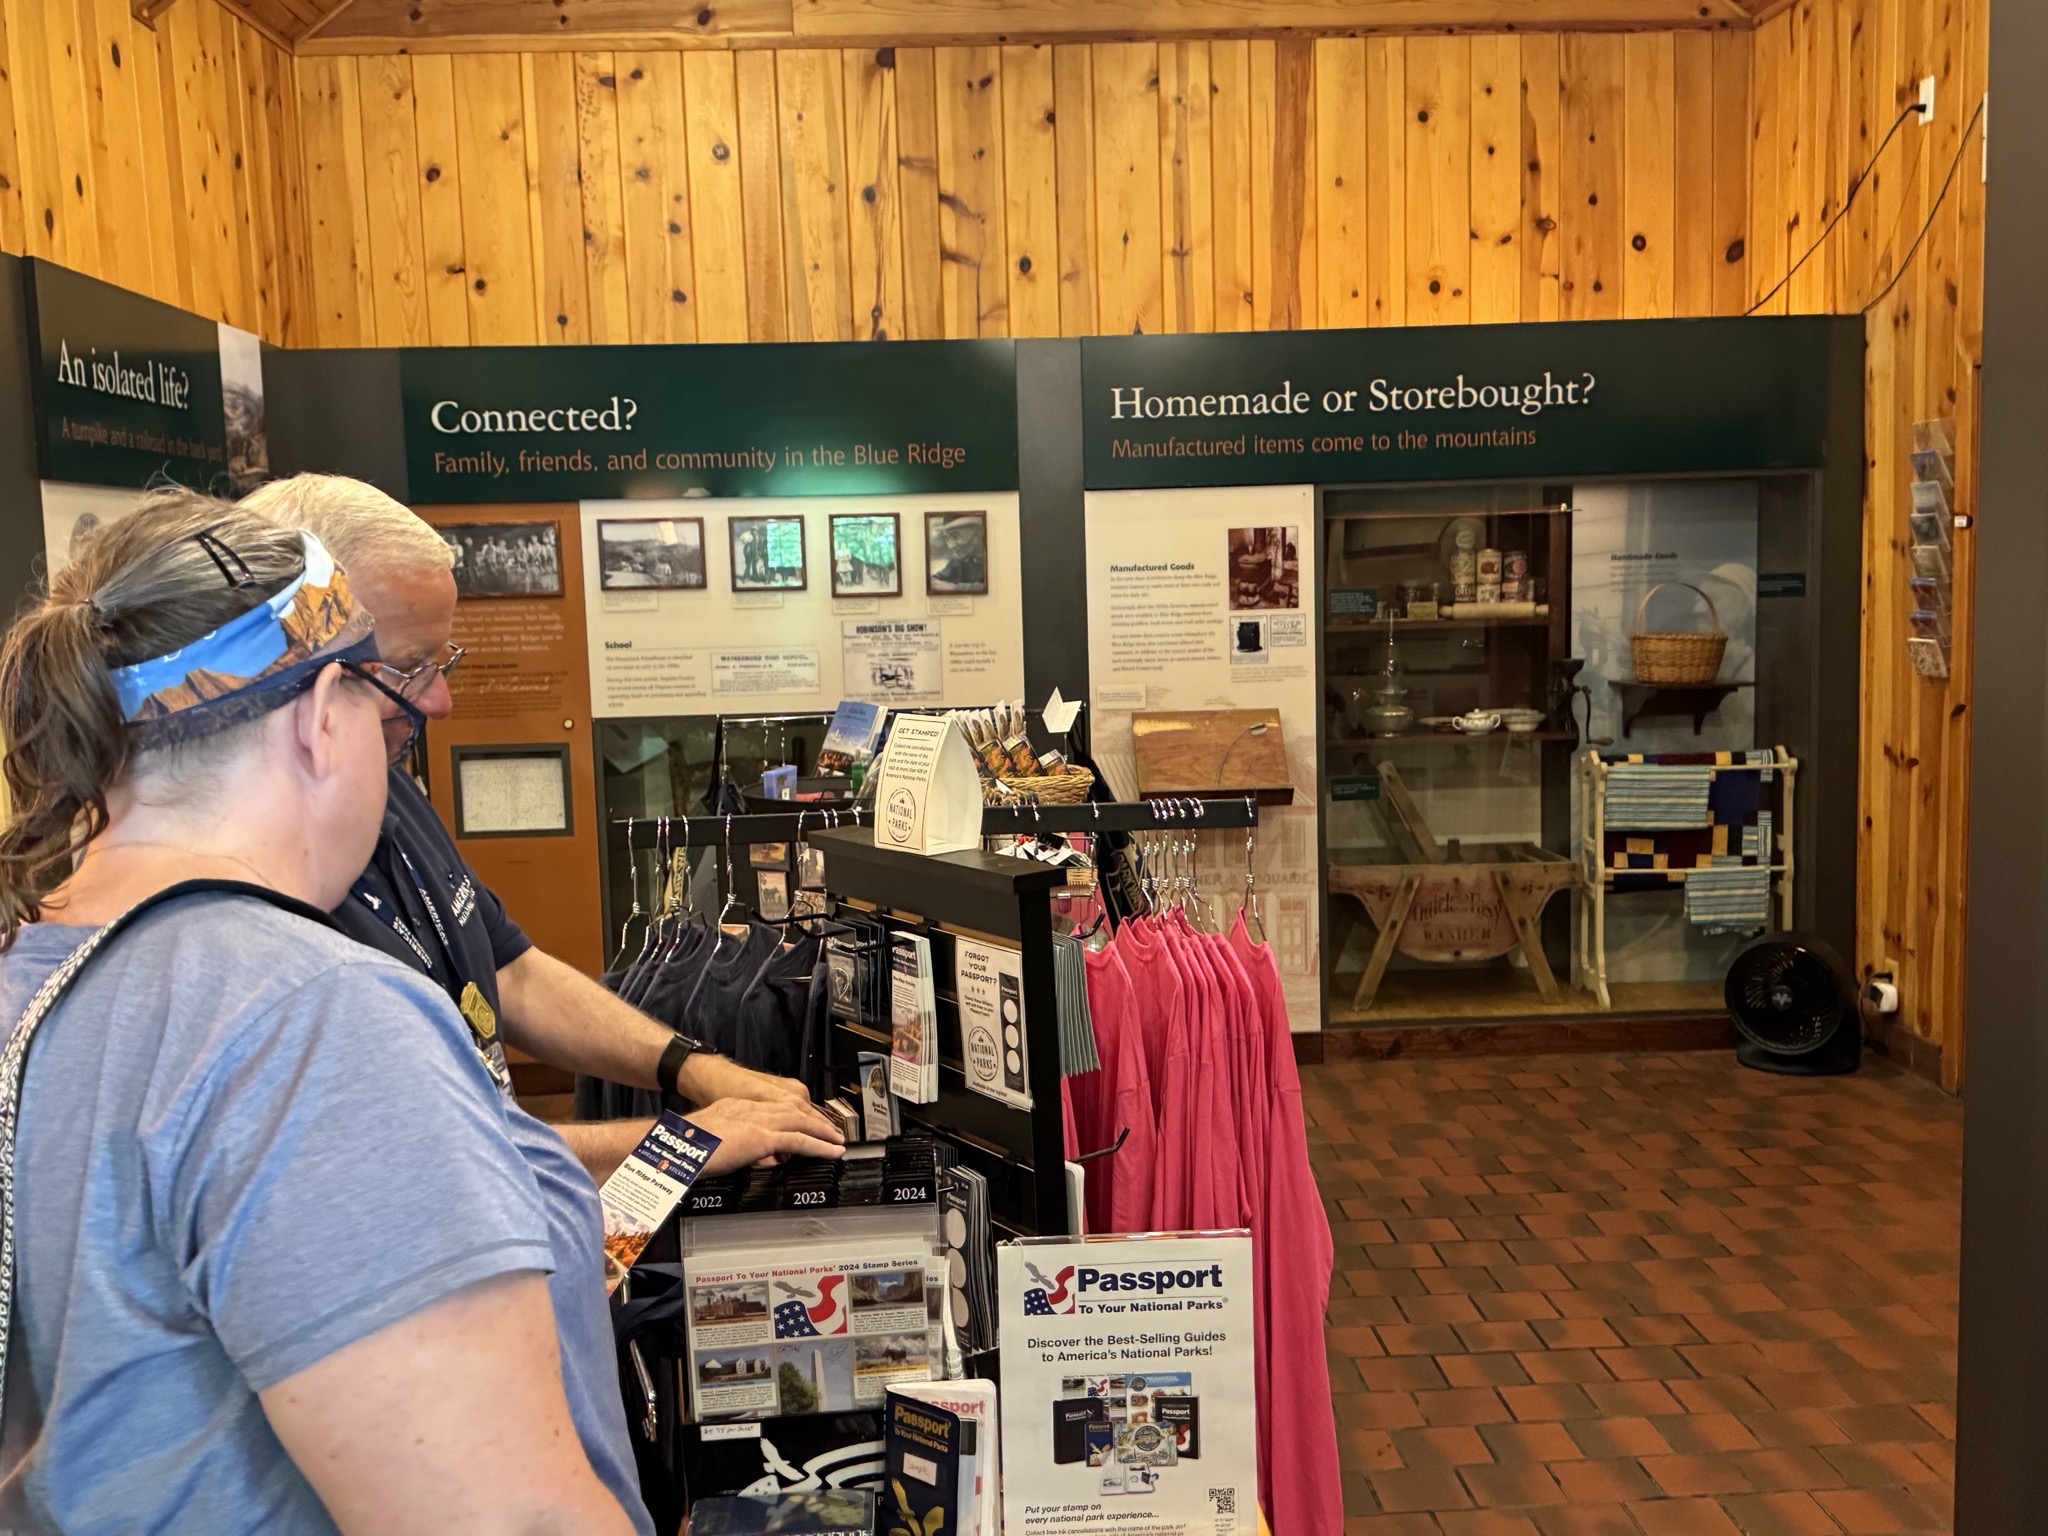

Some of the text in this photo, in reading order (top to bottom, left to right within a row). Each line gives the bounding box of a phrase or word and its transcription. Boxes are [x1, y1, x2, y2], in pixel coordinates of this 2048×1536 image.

[57, 338, 189, 410] An isolated life?
[1111, 372, 1597, 420] Homemade or Storebought?
[430, 396, 638, 434] Connected?
[62, 416, 70, 439] A
[72, 421, 108, 449] turnpike
[110, 426, 127, 448] and
[1112, 426, 1537, 459] Manufactured items come to the mountains
[434, 441, 967, 479] Family, friends, and community in the Blue Ridge
[1110, 563, 1195, 573] Manufactured Goods
[856, 623, 927, 633] ROBINSON'S BIG SHOW!
[604, 640, 632, 649] School
[911, 728, 940, 737] STAMPED!
[889, 803, 913, 819] NATIONAL
[891, 817, 908, 832] PARKS
[964, 951, 990, 963] FORGOT
[969, 962, 987, 973] YOUR
[961, 969, 998, 986] PASSPORT?
[971, 1043, 995, 1057] NATIONAL
[976, 1057, 993, 1070] PARKS
[651, 1124, 708, 1163] Passport
[643, 1140, 696, 1174] To Your National Parks
[623, 1162, 674, 1196] Blue Ridge Parkway
[793, 1191, 826, 1205] 2023
[894, 1186, 927, 1201] 2024
[691, 1195, 723, 1210] 2022
[695, 1274, 733, 1283] Passport
[749, 1271, 769, 1279] Your
[771, 1268, 807, 1277] National
[838, 1262, 860, 1272] 2024
[862, 1262, 889, 1270] Stamp
[891, 1259, 918, 1267] Series
[1078, 1264, 1223, 1294] Passport
[1079, 1305, 1094, 1314] To
[1098, 1303, 1126, 1313] Your
[1130, 1301, 1183, 1312] National
[1028, 1330, 1226, 1349] Discover the Best-Selling Guides
[1042, 1345, 1213, 1362] to America's National Parks!
[1161, 1407, 1190, 1415] Passport
[894, 1427, 949, 1453] To Your National Parks
[1025, 1503, 1102, 1515] Put your stamp on
[1025, 1511, 1159, 1526] every national park experience...
